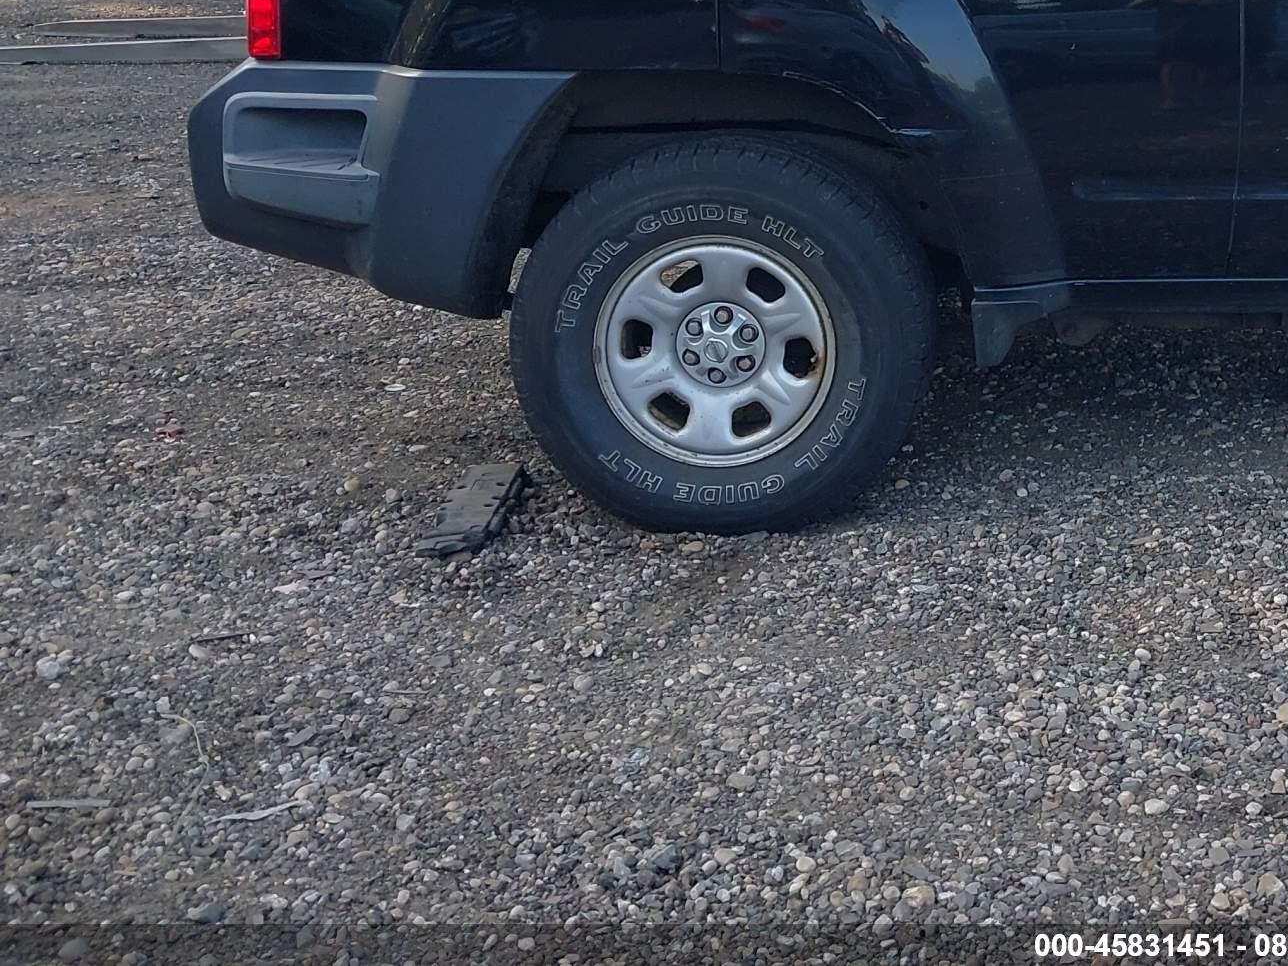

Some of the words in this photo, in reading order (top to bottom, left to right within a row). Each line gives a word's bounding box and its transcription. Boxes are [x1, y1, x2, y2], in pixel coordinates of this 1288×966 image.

[554, 238, 629, 333] TRAIL
[635, 203, 749, 235] GUIDE
[760, 214, 825, 260] HLT
[793, 376, 867, 472] TRAIL
[597, 448, 664, 493] HLT
[672, 473, 785, 505] GUIDE
